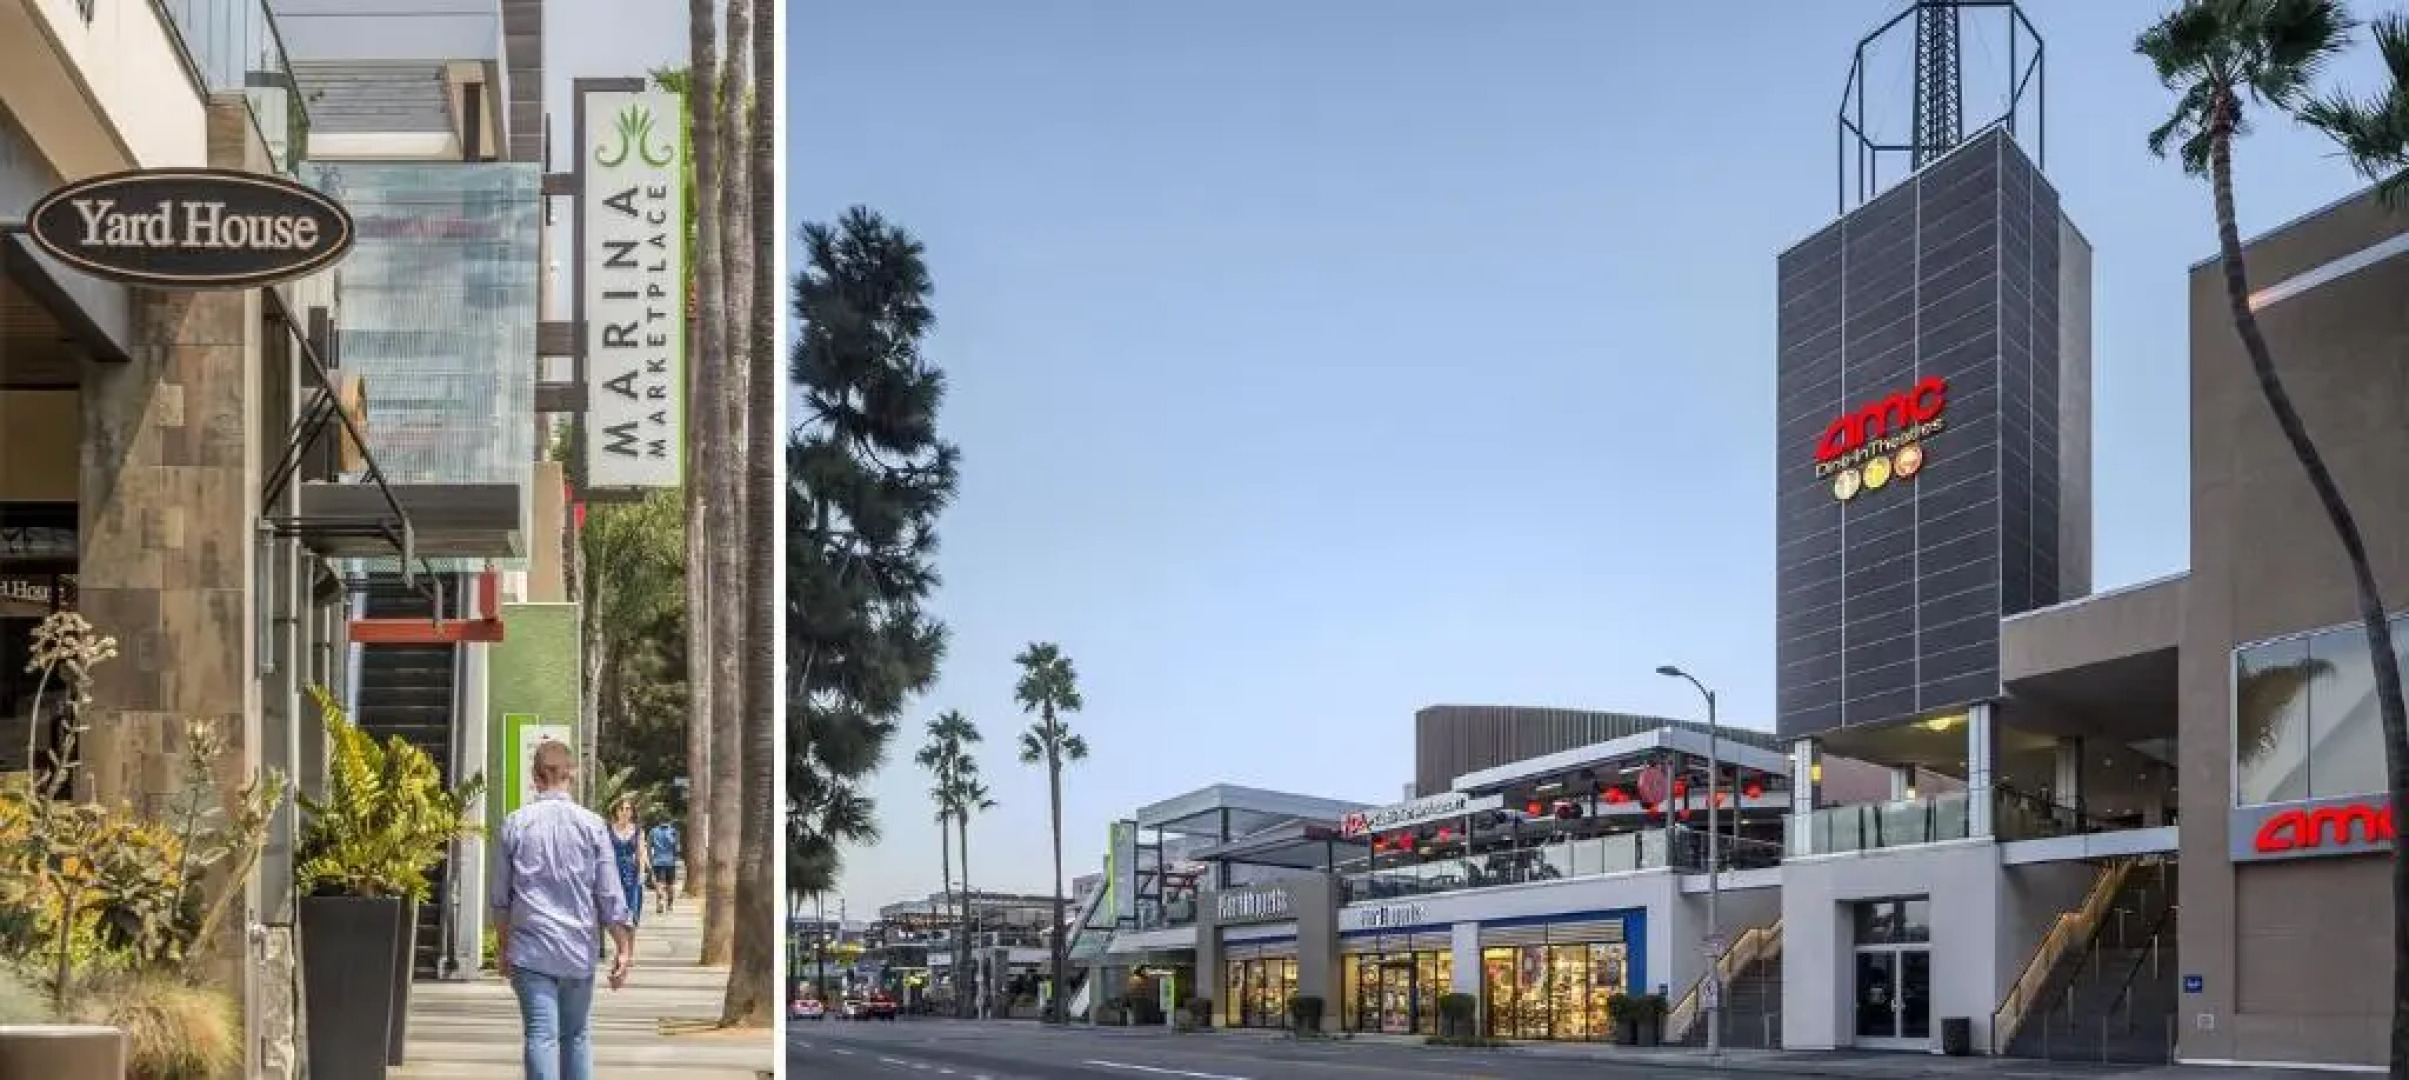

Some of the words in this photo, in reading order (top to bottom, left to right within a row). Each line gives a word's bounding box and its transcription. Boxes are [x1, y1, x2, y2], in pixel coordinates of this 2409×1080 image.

[72, 199, 174, 247] Yard
[179, 200, 320, 248] House
[602, 186, 639, 457] MARINA
[647, 185, 667, 458] MARKETPLACE
[1814, 376, 1948, 464] amc
